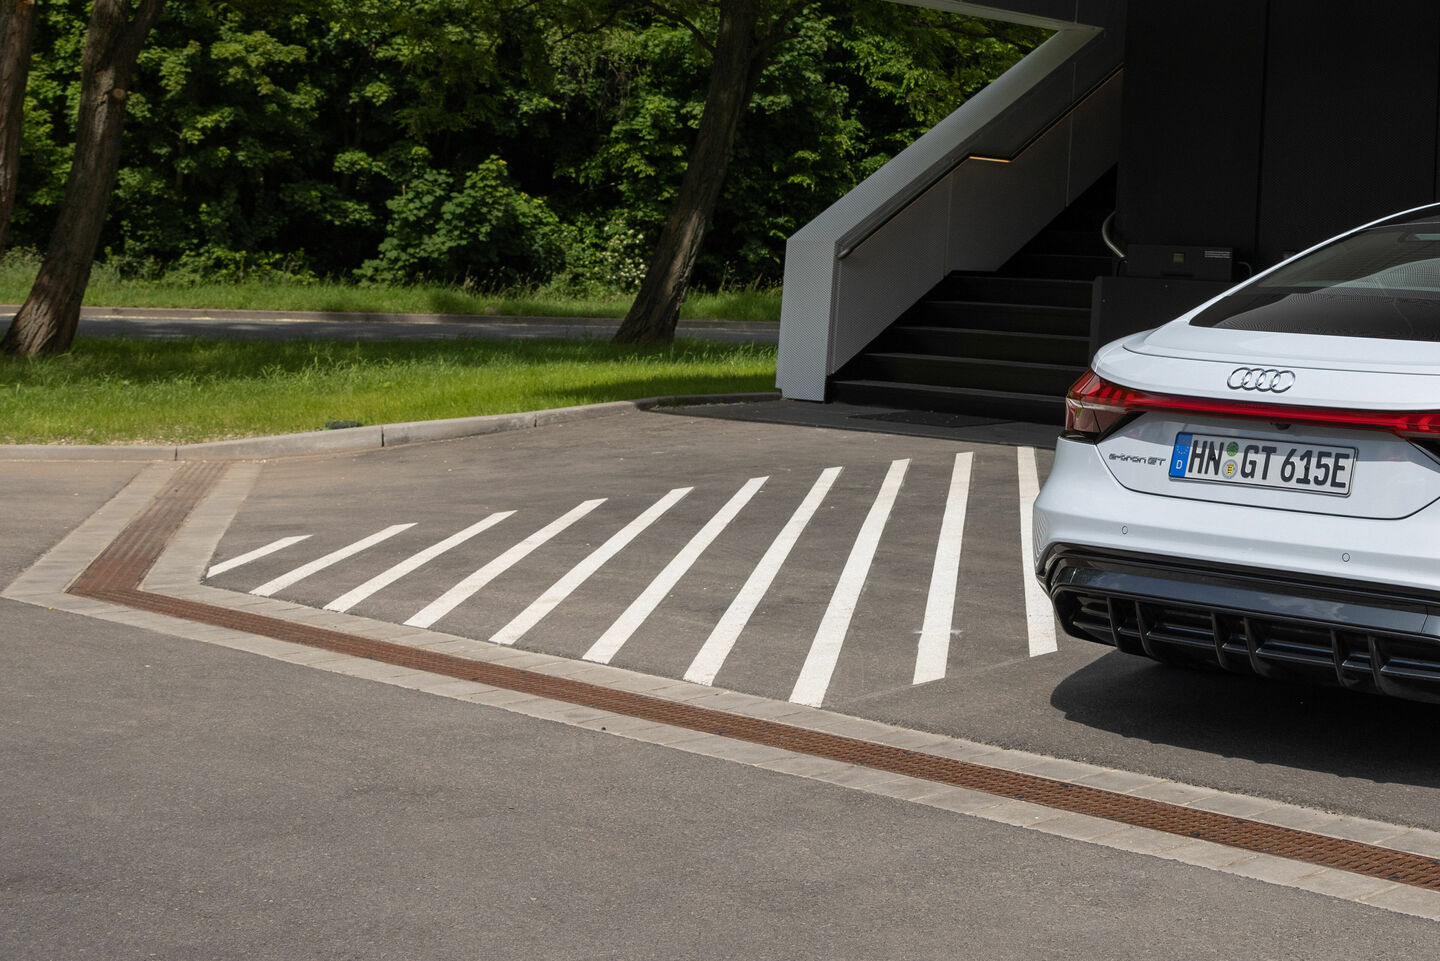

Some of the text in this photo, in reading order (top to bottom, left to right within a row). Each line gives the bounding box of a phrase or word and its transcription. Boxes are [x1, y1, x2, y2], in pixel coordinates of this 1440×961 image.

[1108, 452, 1167, 466] e-tron GT
[1175, 459, 1183, 470] D
[1188, 440, 1350, 488] HN GT 615E
